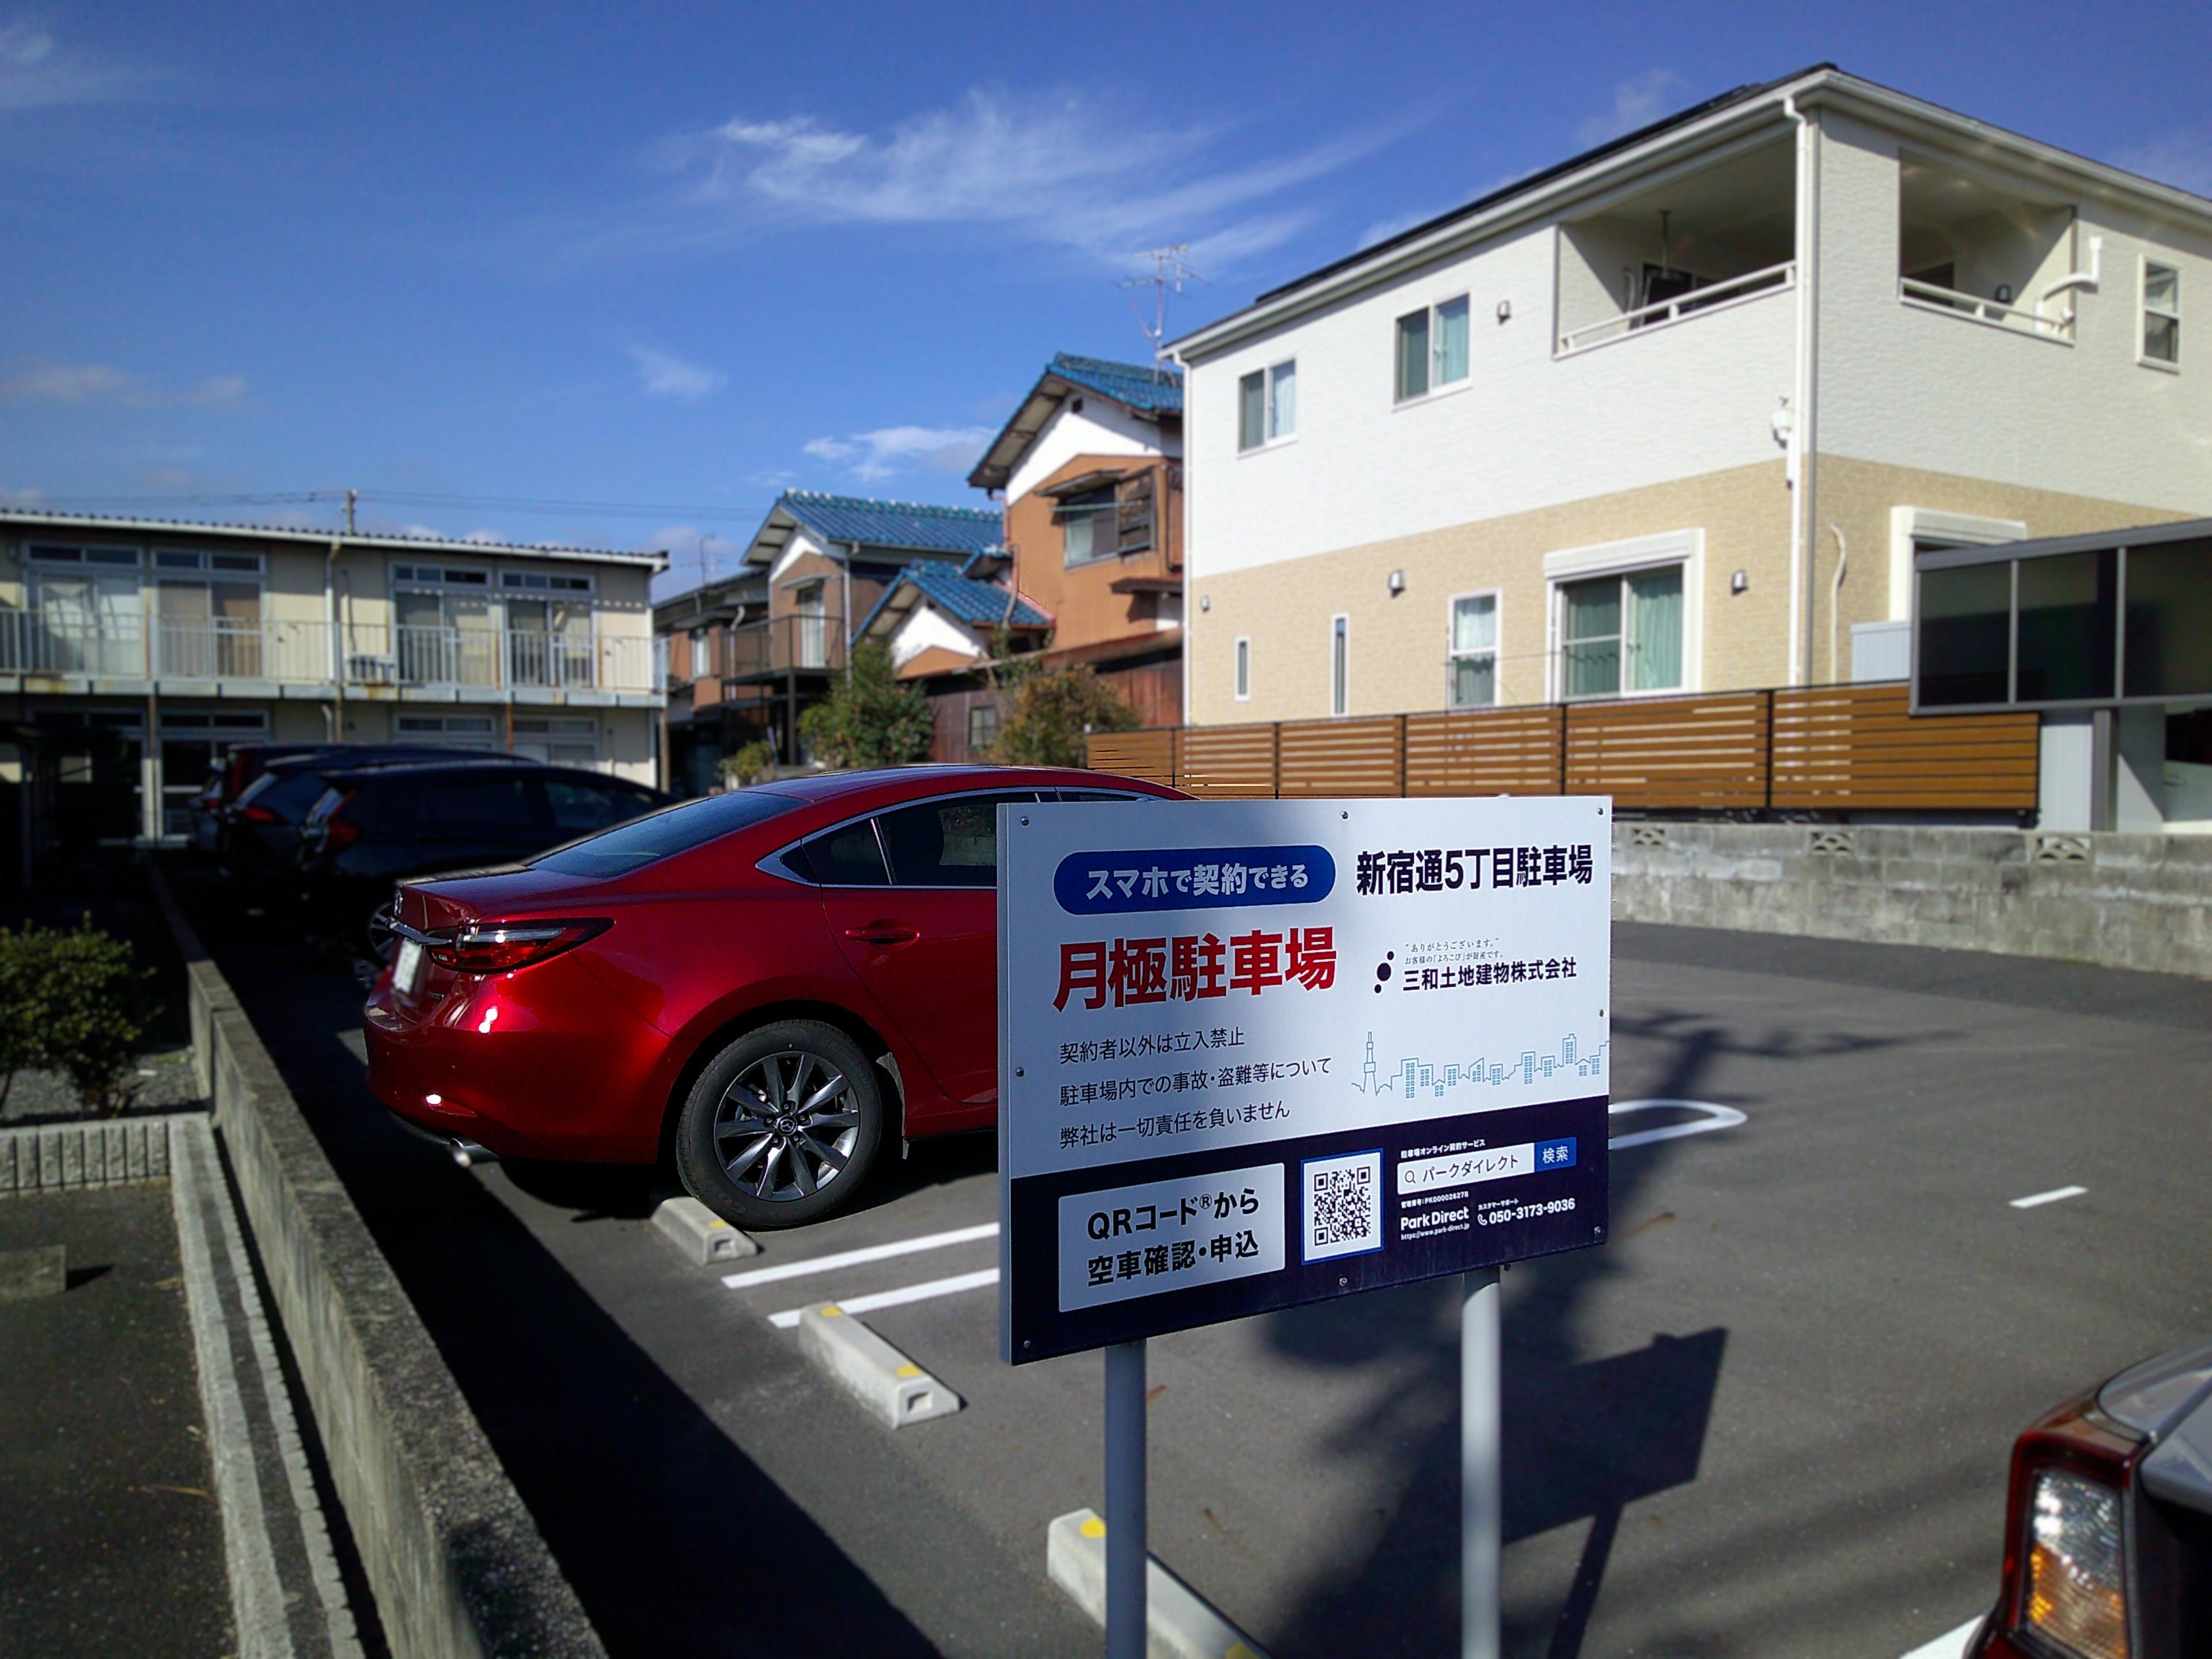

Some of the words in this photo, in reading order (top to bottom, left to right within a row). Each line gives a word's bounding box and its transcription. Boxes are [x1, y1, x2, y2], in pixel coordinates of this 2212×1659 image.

[1086, 862, 1309, 901] スマホで契約できる
[1357, 844, 1593, 896] 新宿通5丁目駐車場
[1052, 926, 1336, 1013] 月極駐車場
[1403, 957, 1577, 991] 三和土地建物株式会社
[1060, 1027, 1244, 1065] 契約者以外は立入禁止
[1059, 1058, 1332, 1107] 駐車場内での事故・盗難等について
[1060, 1100, 1290, 1149] 弊社は一切責任を負いません
[1423, 1154, 1518, 1183] パークダイレクト
[1542, 1145, 1569, 1165] 検索
[1400, 1213, 1430, 1231] Park
[1431, 1206, 1469, 1225] Direct
[1489, 1198, 1576, 1224] 050-3173-9036
[1400, 1222, 1470, 1241] https://www.park-direct.jp
[1088, 1230, 1259, 1287] 空車確認・申込
